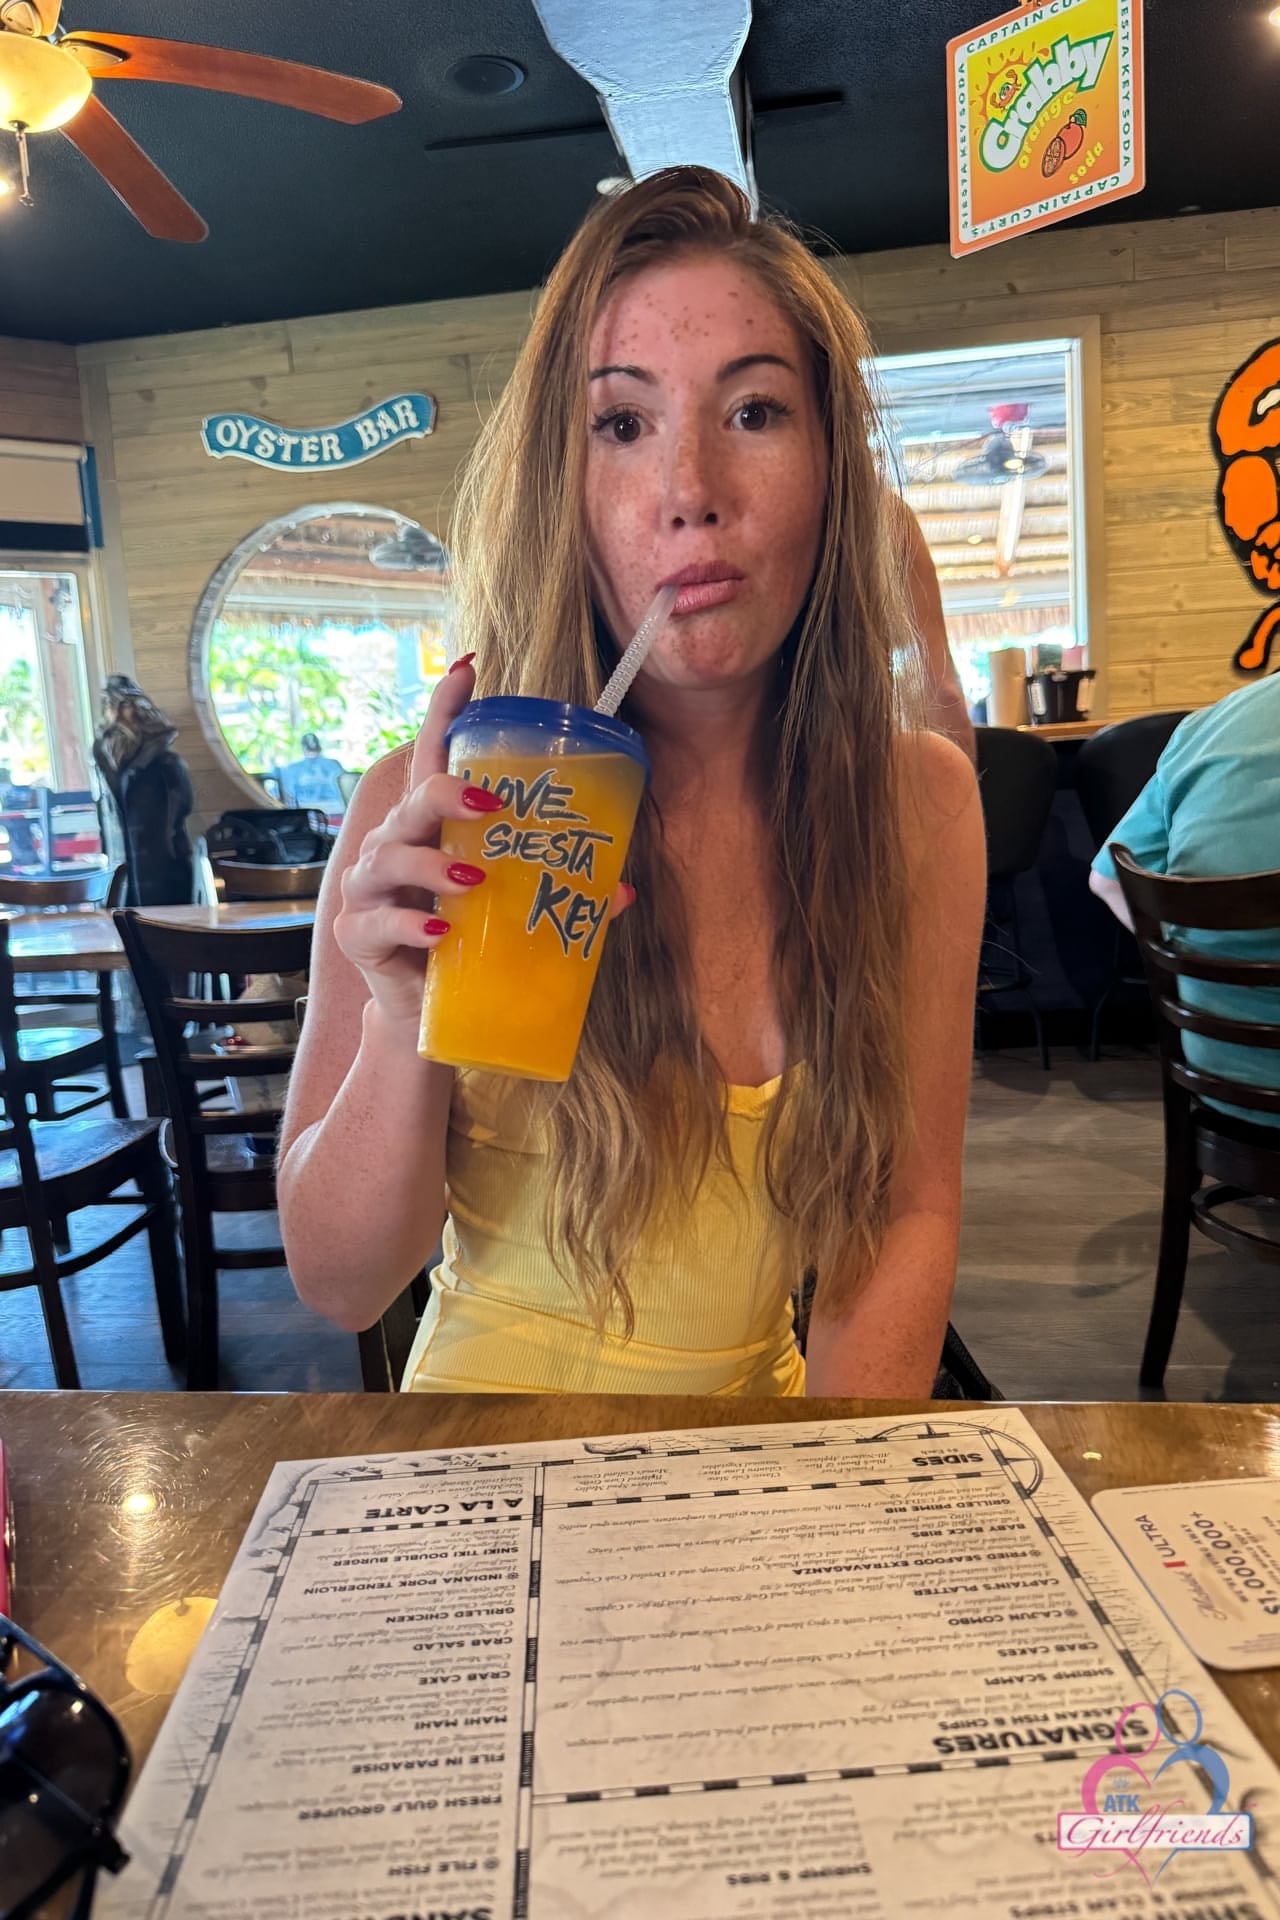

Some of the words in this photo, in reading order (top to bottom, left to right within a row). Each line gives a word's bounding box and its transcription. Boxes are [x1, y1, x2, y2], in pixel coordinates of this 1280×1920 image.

[966, 10, 1044, 54] CAPTAIN
[1122, 63, 1131, 101] KEY
[957, 62, 966, 117] SODA
[979, 31, 1114, 173] Crabby
[1018, 90, 1075, 169] orange
[958, 123, 967, 157] KEY
[1122, 108, 1131, 167] SODA
[1069, 142, 1104, 185] soda
[960, 163, 968, 229] SIESTA
[1039, 175, 1120, 214] CAPTAIN
[215, 418, 345, 463] OYSTER
[354, 398, 420, 450] BAR
[482, 822, 614, 881] SIESTA
[527, 871, 609, 959] KEY
[911, 1453, 983, 1468] SIDES
[458, 1500, 494, 1513] LA
[503, 1498, 524, 1509] A
[911, 1504, 953, 1512] PRIME
[955, 1500, 1012, 1508] GRILLED
[364, 1504, 450, 1519] CARTE
[946, 1528, 986, 1536] BACK
[988, 1524, 1027, 1532] BABY
[912, 1531, 944, 1539] RIBS
[1130, 1513, 1179, 1558] ULTRA
[393, 1553, 449, 1562] DOUBLE
[453, 1550, 479, 1558] TIKI
[484, 1547, 520, 1556] SNIKI
[986, 1551, 1029, 1560] FRIED
[333, 1557, 389, 1567] BURGER
[913, 1555, 983, 1566] SEAFOOD
[793, 1562, 911, 1575] EXTRAVAGANZA
[398, 1579, 438, 1588] PORK
[443, 1574, 503, 1584] INDIANA
[982, 1579, 1061, 1591] CAPTAIN'S
[303, 1583, 393, 1595] TENDERLOIN
[912, 1585, 979, 1596] PLATTER
[386, 1613, 449, 1623] CHICKEN
[454, 1608, 515, 1618] GRILLED
[1008, 1611, 1064, 1621] CAJUN
[947, 1615, 1006, 1626] COMBO
[412, 1641, 465, 1652] SALAD
[470, 1637, 513, 1647] CRAB
[1054, 1642, 1100, 1653] CRAB
[997, 1647, 1052, 1658] CAKES
[418, 1675, 462, 1685] CAKE
[466, 1671, 511, 1681] CRAB
[414, 1719, 459, 1730] MAHI
[464, 1715, 508, 1726] MAHI
[937, 1719, 991, 1732] CHIPS
[1011, 1714, 1051, 1726] FISH
[932, 1721, 1150, 1754] SIGNATURES
[445, 1757, 464, 1767] IN
[469, 1753, 505, 1765] FILE
[351, 1759, 440, 1774] PARADISE
[392, 1800, 439, 1813] GULF
[445, 1795, 503, 1809] FRESH
[298, 1805, 386, 1821] GROUPER
[437, 1859, 478, 1874] FILE
